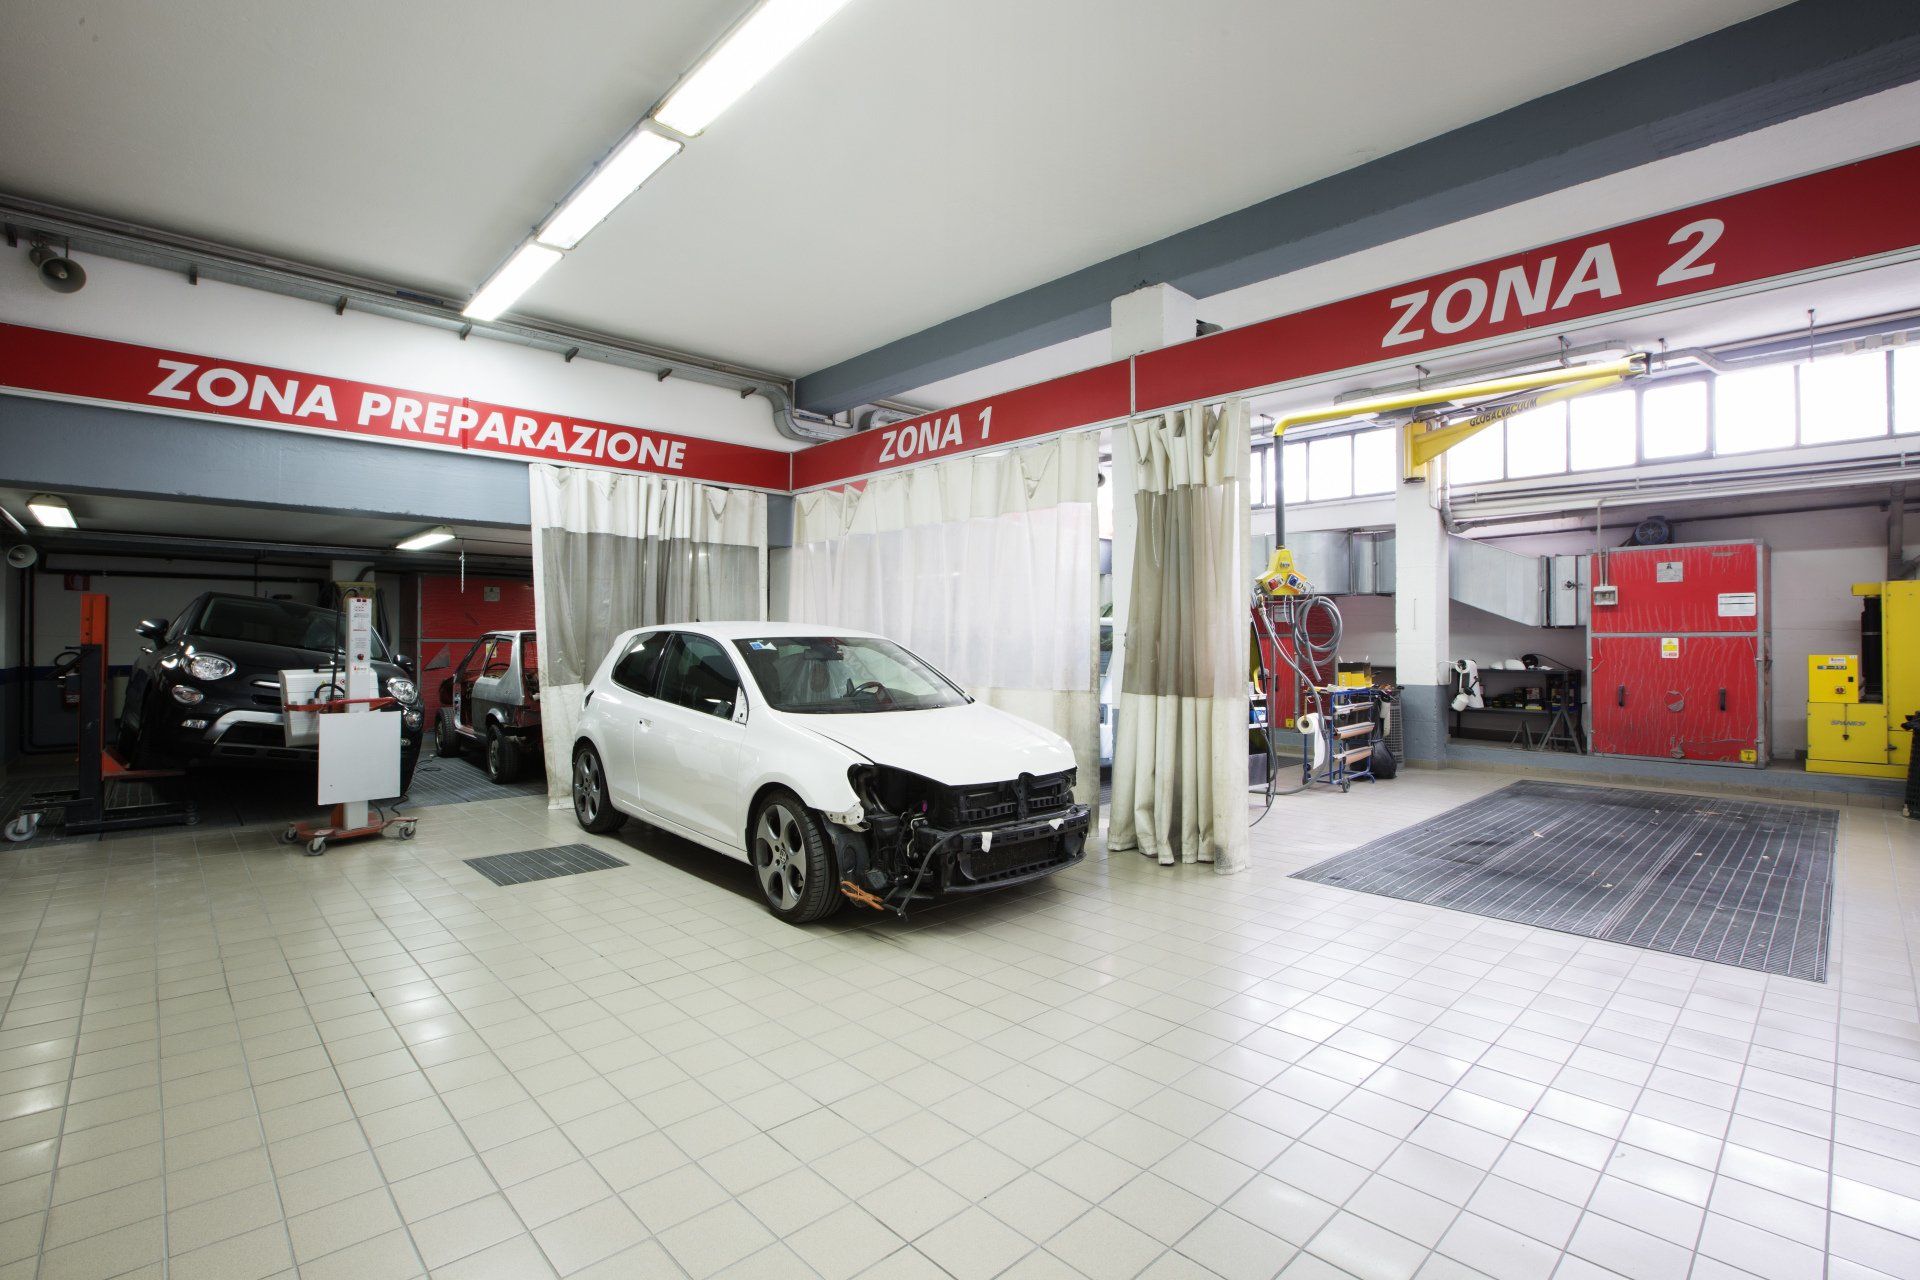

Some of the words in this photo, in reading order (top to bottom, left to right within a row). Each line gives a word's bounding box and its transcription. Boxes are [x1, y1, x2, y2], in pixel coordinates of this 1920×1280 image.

[1381, 242, 1622, 348] ZONA
[1656, 218, 1725, 287] 2
[148, 358, 337, 422] ZONA
[357, 391, 687, 470] PREPARAZIONE
[879, 413, 963, 463] ZONA
[978, 405, 993, 440] 1
[1469, 397, 1538, 427] GLOBALVACUUM
